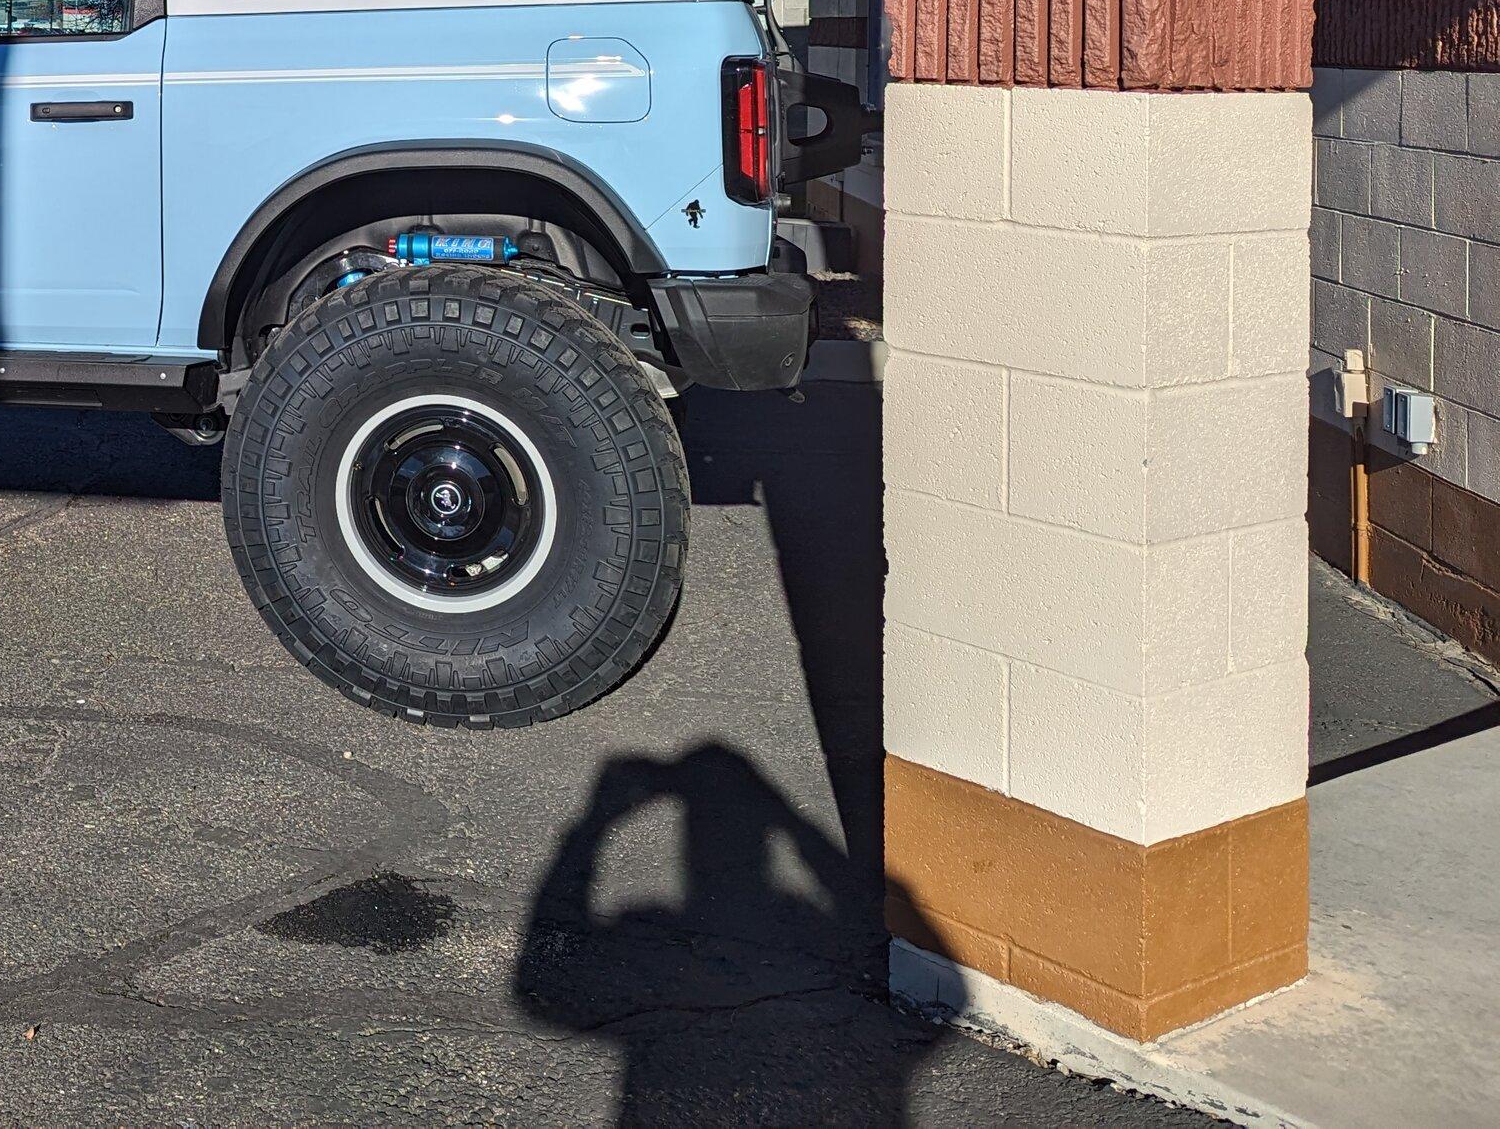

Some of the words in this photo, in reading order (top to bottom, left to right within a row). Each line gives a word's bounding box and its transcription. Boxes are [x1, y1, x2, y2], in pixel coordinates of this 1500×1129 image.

[435, 238, 491, 248] KING
[296, 437, 323, 543] TRAIL
[320, 357, 505, 430] GRAPPLER
[329, 587, 531, 656] NITTO
